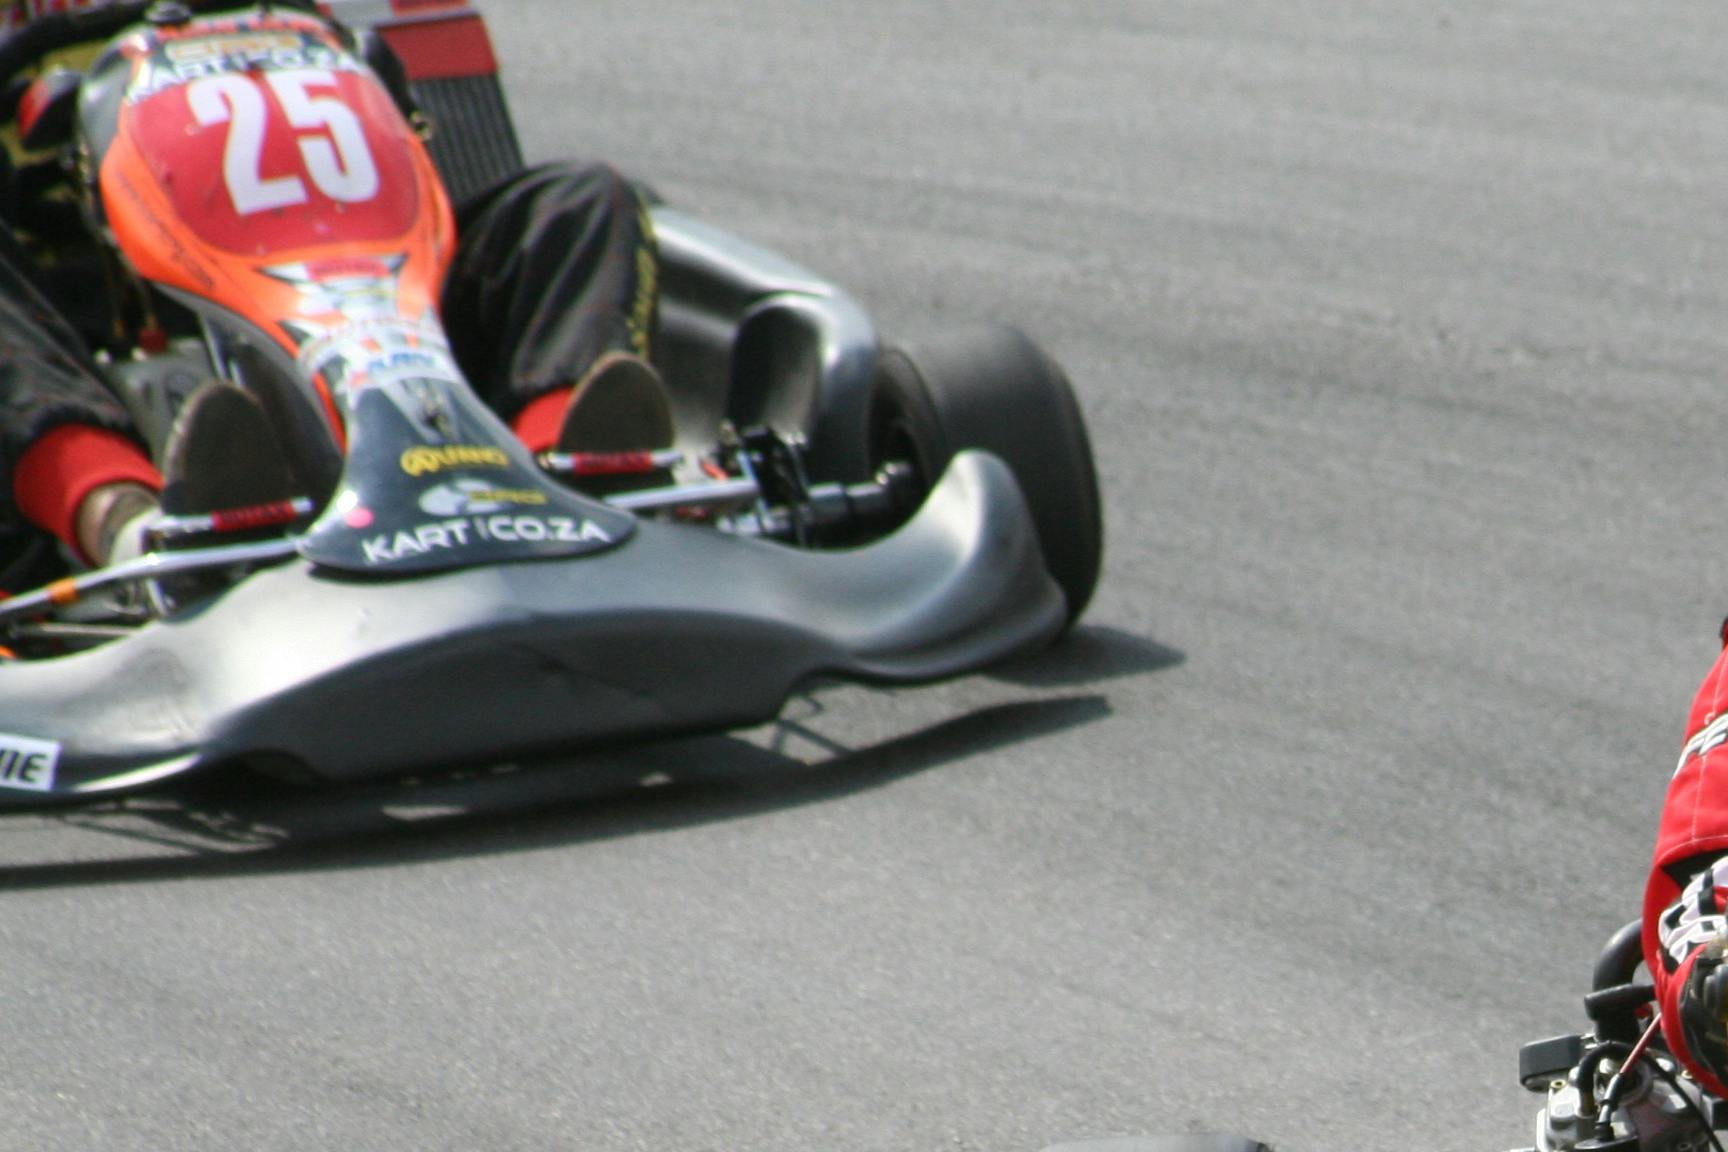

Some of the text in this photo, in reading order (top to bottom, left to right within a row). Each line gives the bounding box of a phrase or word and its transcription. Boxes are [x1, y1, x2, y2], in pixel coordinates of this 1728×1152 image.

[186, 69, 379, 216] 25
[362, 518, 470, 566] KART
[0, 748, 48, 784] IE
